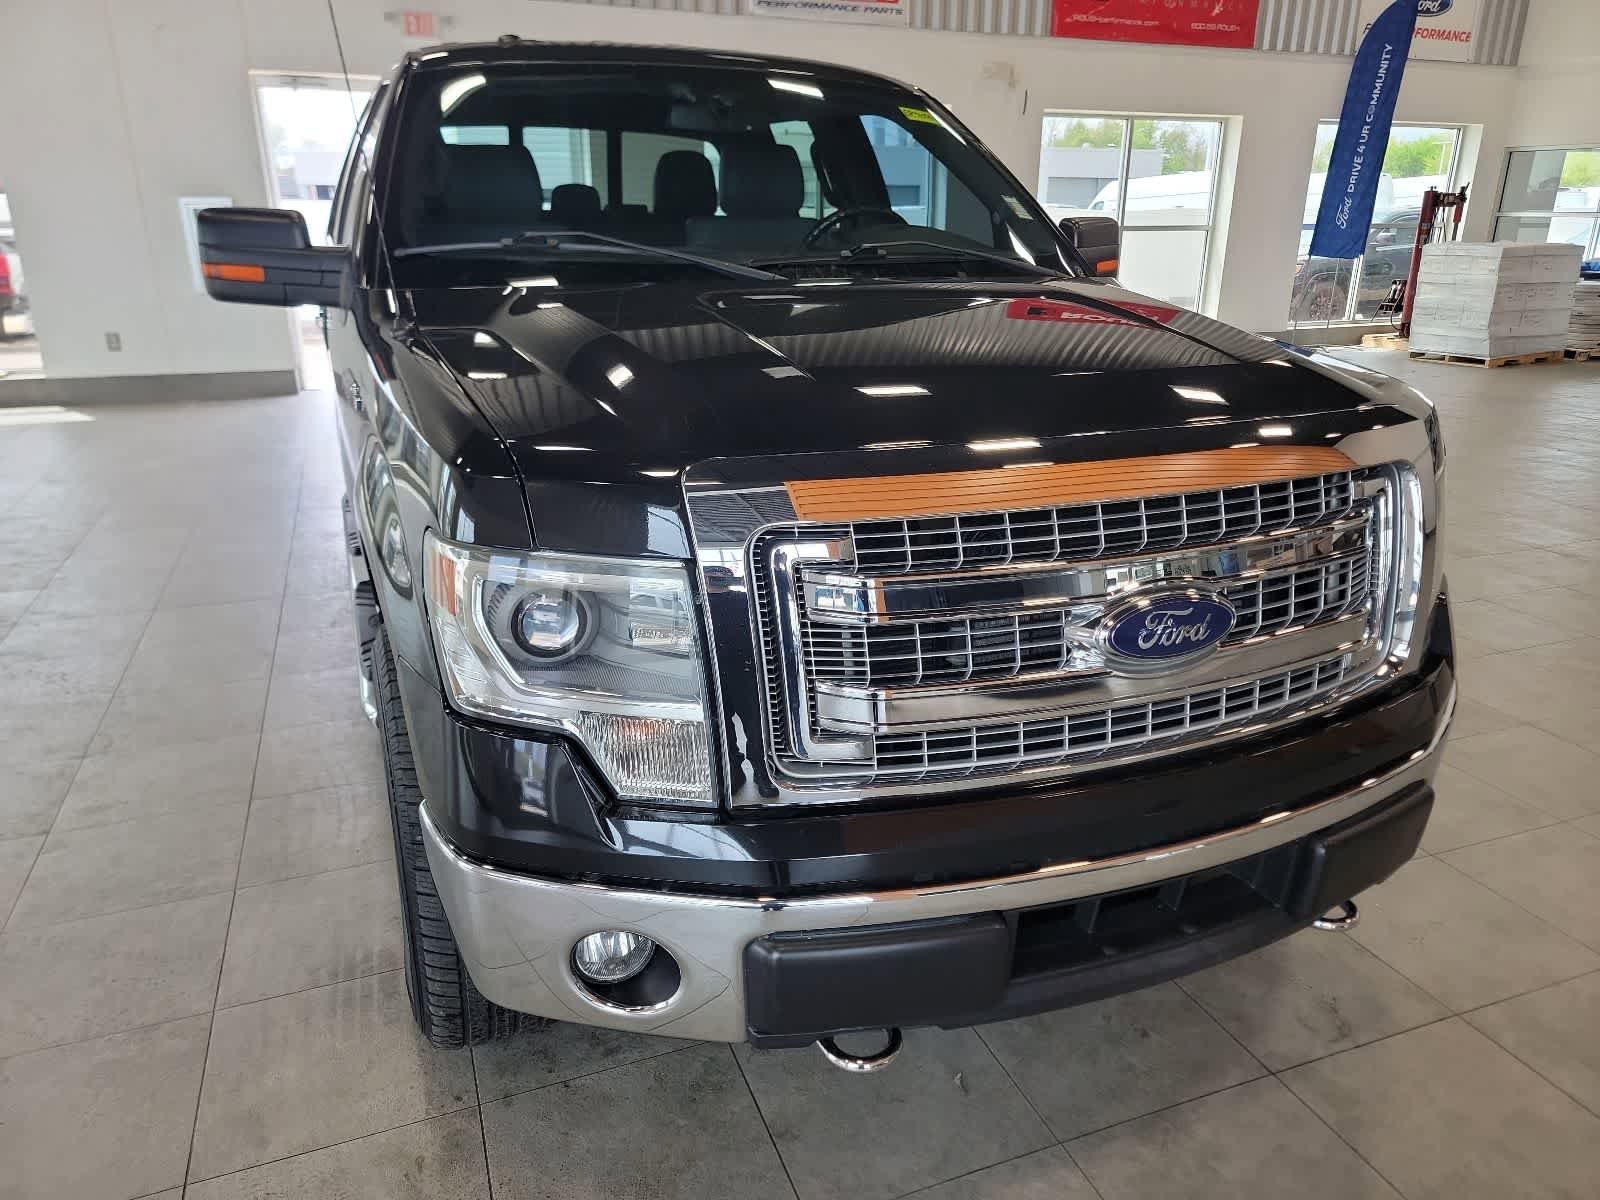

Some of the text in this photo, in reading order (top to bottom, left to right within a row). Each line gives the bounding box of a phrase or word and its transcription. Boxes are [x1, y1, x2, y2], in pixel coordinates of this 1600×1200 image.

[756, 0, 904, 15] PERFORMANCE PARTS
[1365, 43, 1393, 122] COMMUNITY
[1356, 144, 1366, 153] 4
[1359, 125, 1371, 143] UR
[1347, 155, 1364, 193] DRIVE
[1335, 195, 1352, 229] Ford
[1137, 607, 1213, 650] Ford
